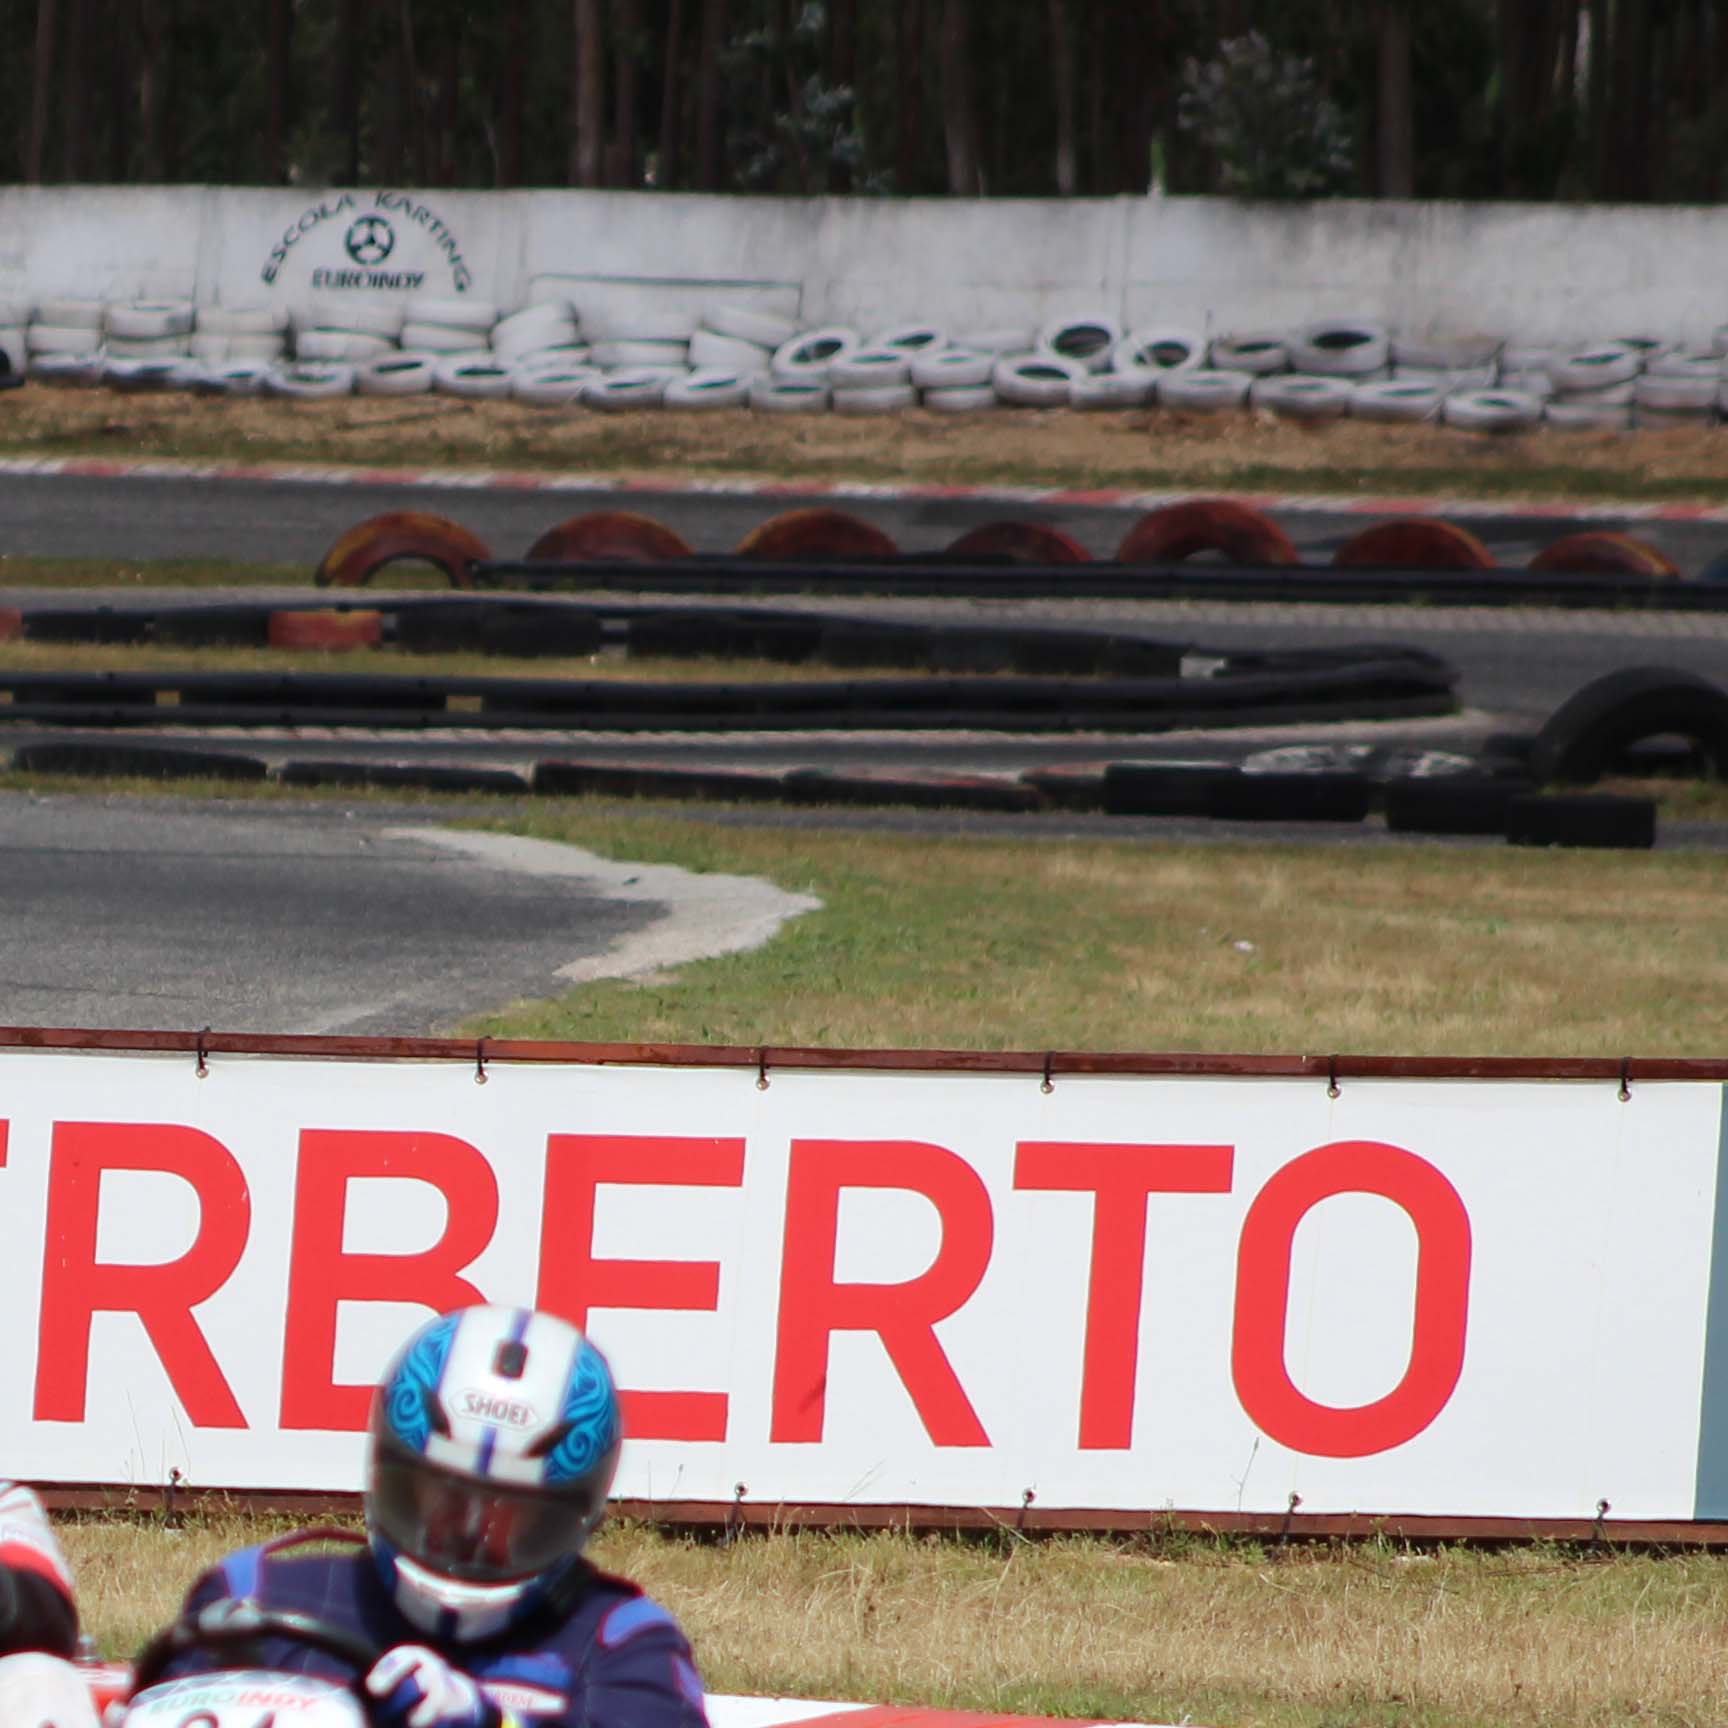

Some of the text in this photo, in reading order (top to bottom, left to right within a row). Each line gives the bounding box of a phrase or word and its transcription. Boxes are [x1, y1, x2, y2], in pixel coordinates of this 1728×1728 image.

[261, 190, 473, 293] ESCOLA KARTING
[462, 1392, 531, 1427] SHOEI
